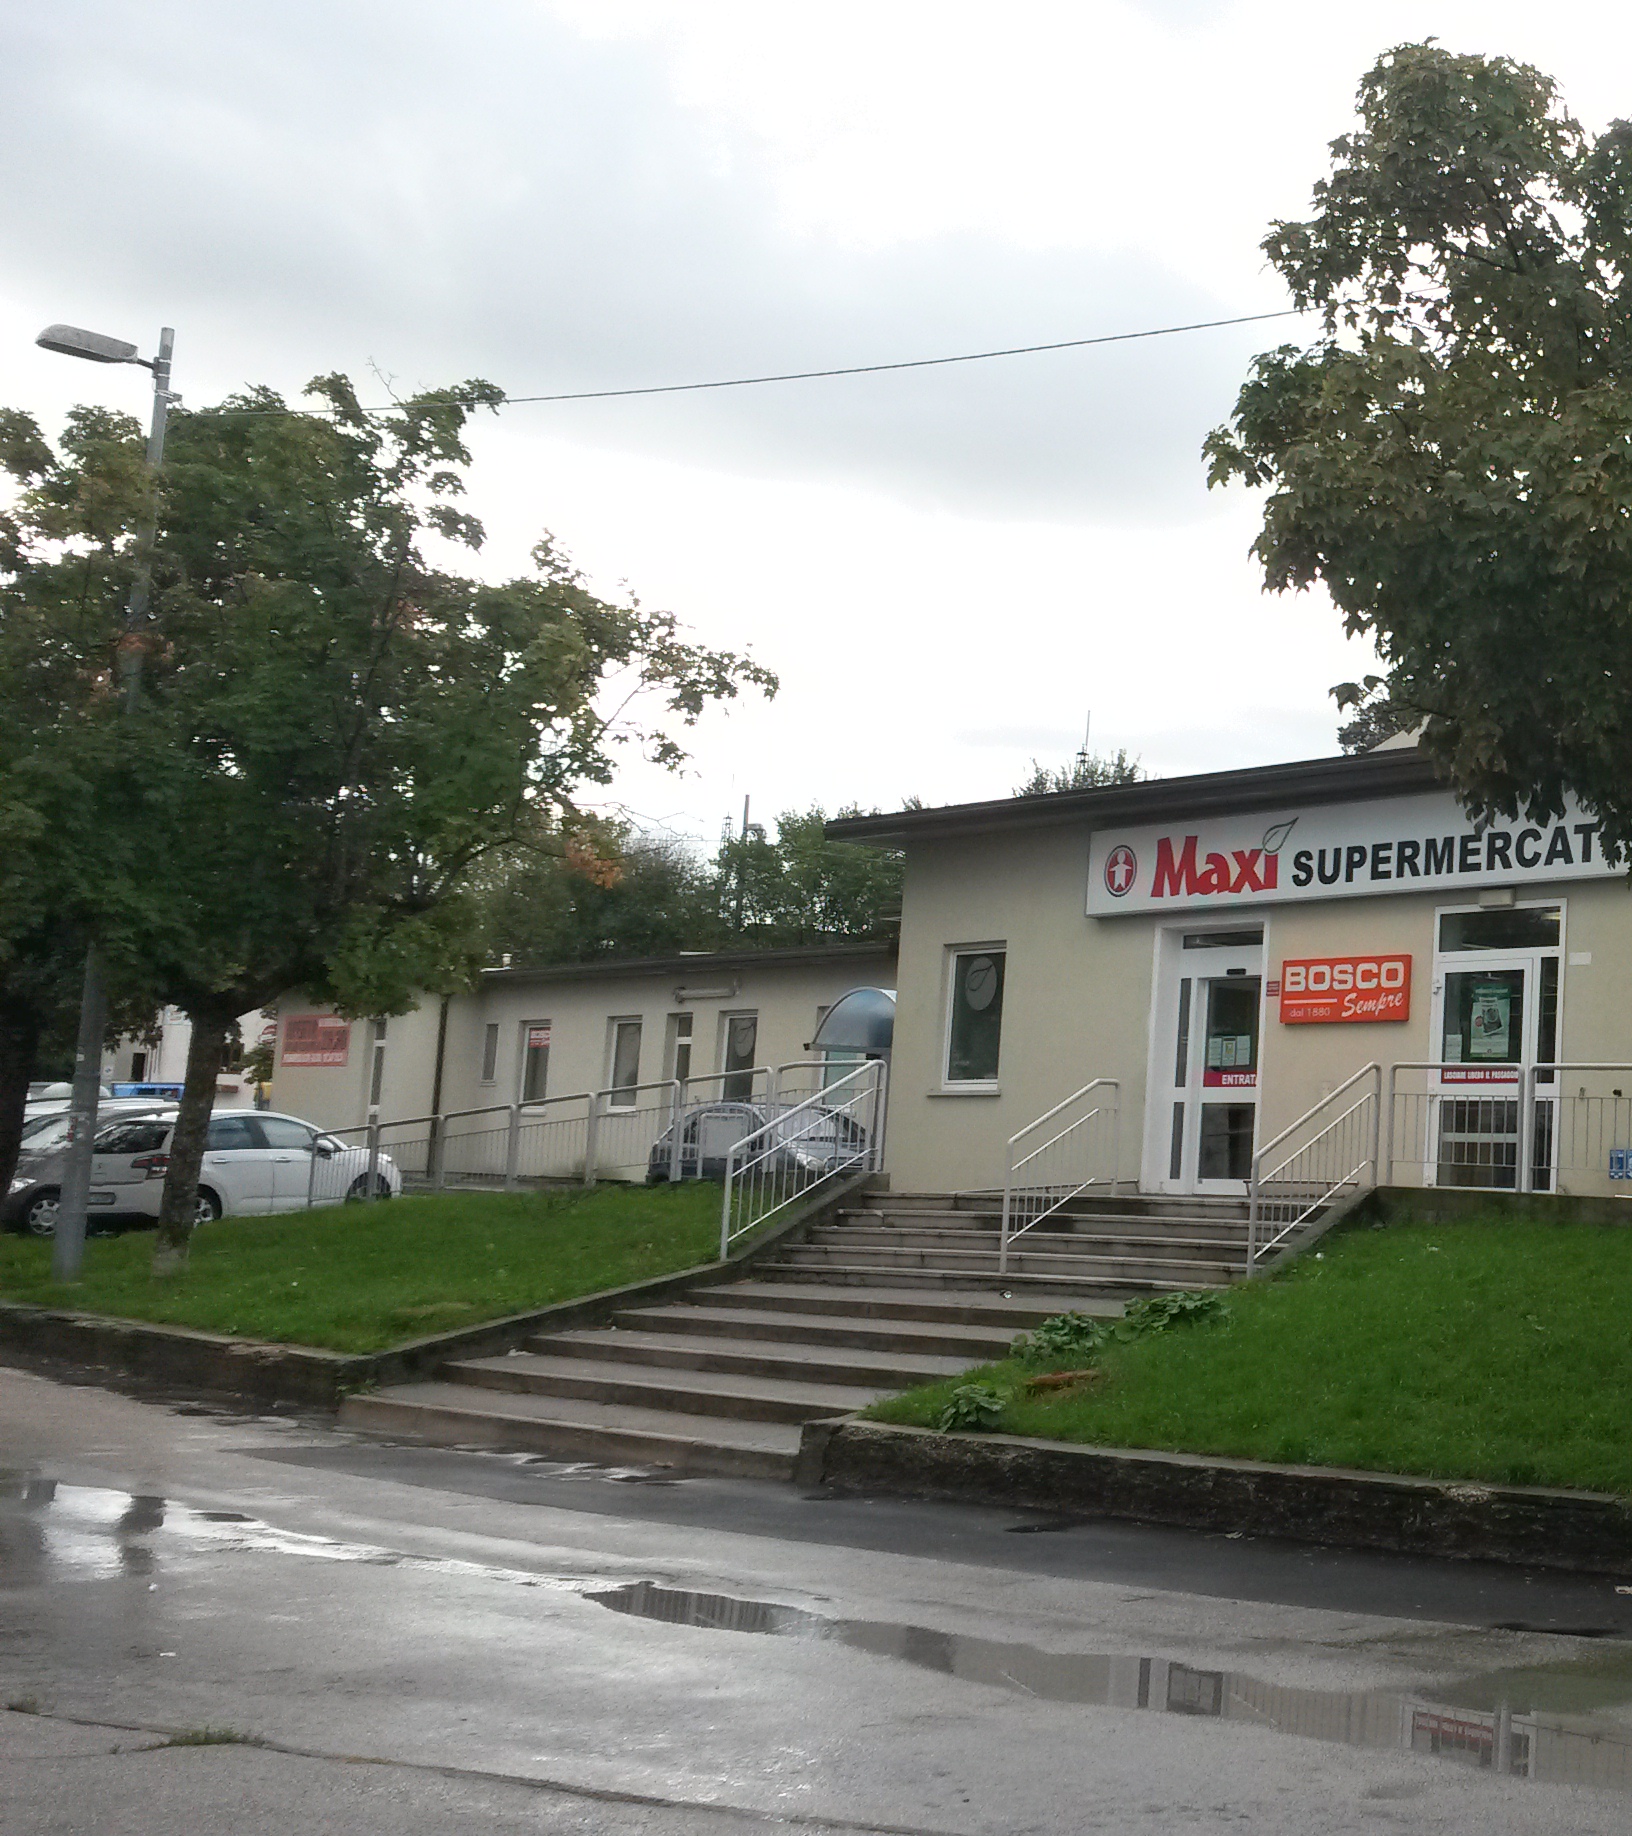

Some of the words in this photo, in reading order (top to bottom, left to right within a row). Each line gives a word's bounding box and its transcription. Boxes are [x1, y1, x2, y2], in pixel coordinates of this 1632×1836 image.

[1150, 835, 1279, 898] Maxi
[1292, 822, 1601, 887] SUPERMERCAT
[1285, 961, 1405, 992] BOSCO
[1289, 1008, 1304, 1018] dal
[1307, 1007, 1330, 1017] 1880
[1341, 992, 1403, 1017] Sempre
[1221, 1074, 1257, 1085] ENTRAT
